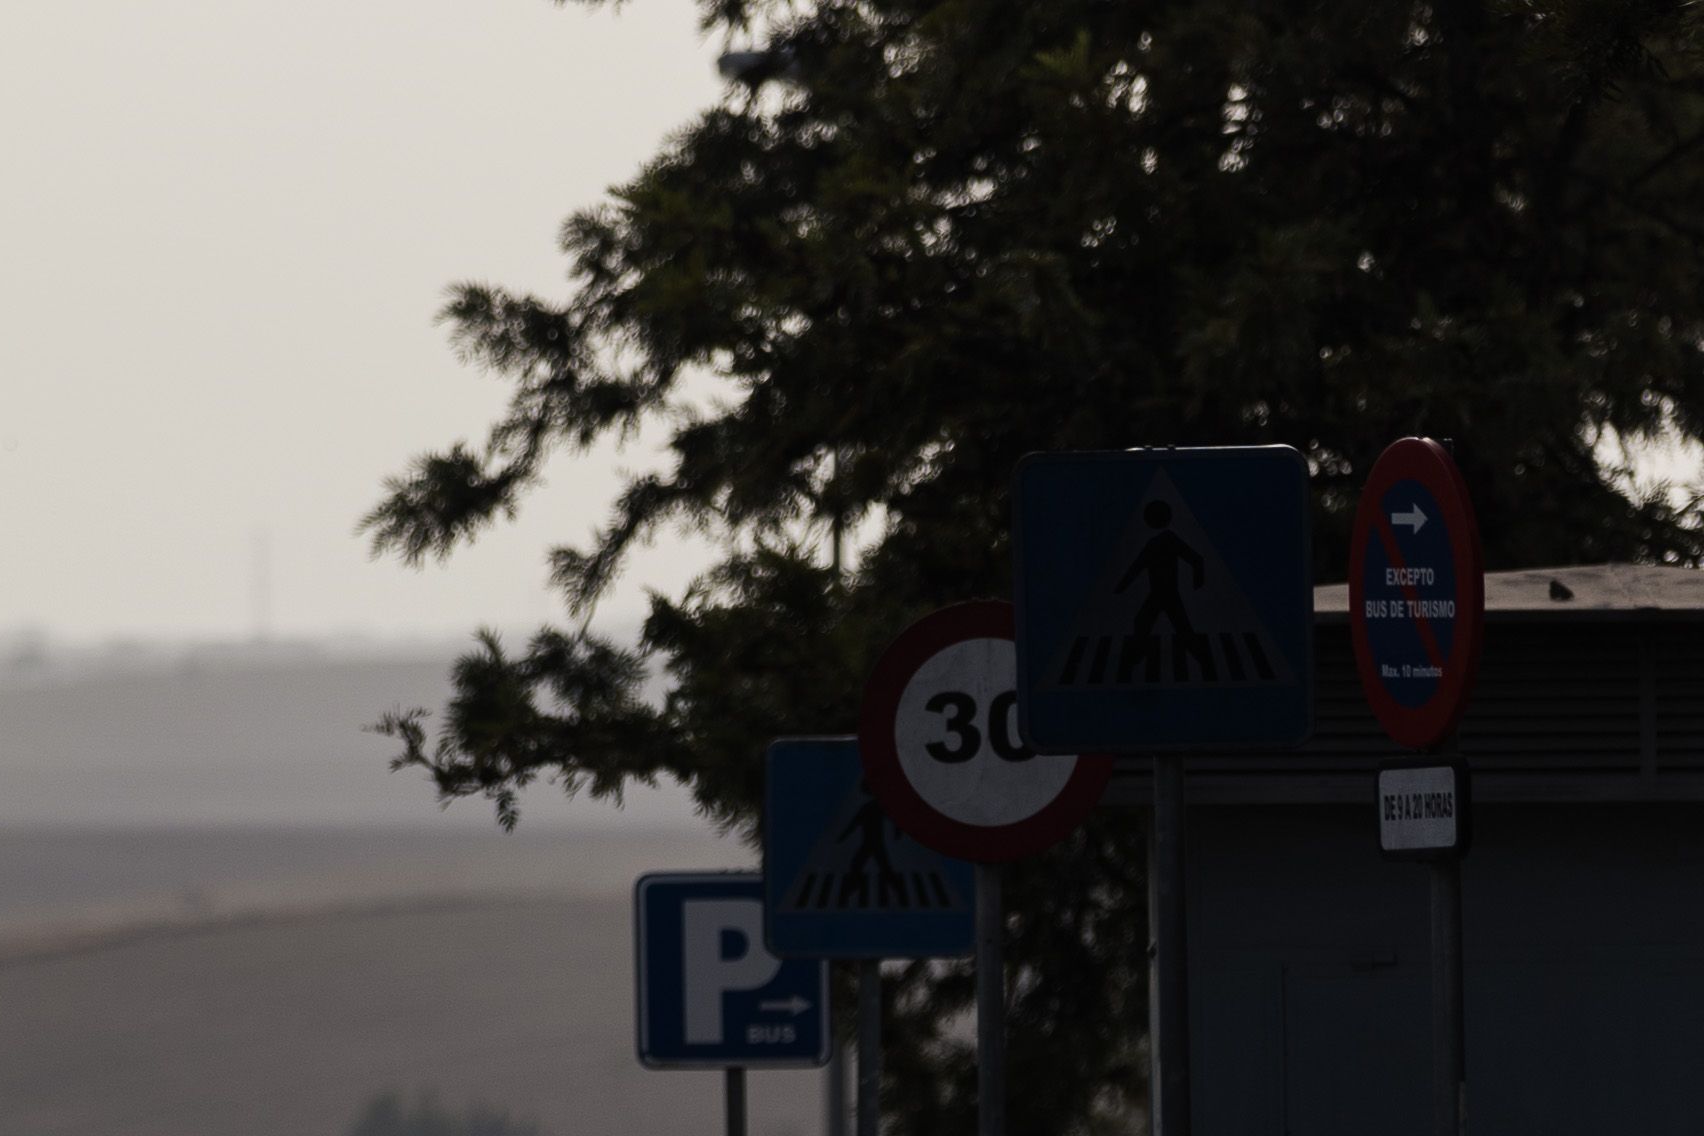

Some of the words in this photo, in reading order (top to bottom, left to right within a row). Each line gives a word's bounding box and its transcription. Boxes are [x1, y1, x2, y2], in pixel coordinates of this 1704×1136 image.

[1385, 567, 1435, 586] EXCEPTO
[1365, 600, 1388, 618] BUS
[1389, 600, 1405, 618] DE
[1406, 600, 1456, 618] TURISMO
[1381, 664, 1400, 678] Max.
[1401, 664, 1411, 678] 10
[1412, 664, 1443, 678] minutos
[925, 691, 1038, 763] 30
[1384, 795, 1396, 820] DE
[1397, 794, 1403, 820] 9
[1405, 794, 1411, 820] A
[1413, 793, 1422, 819] 20
[1424, 792, 1452, 819] HORAS
[682, 896, 783, 1045] P
[746, 1024, 796, 1045] BUS
